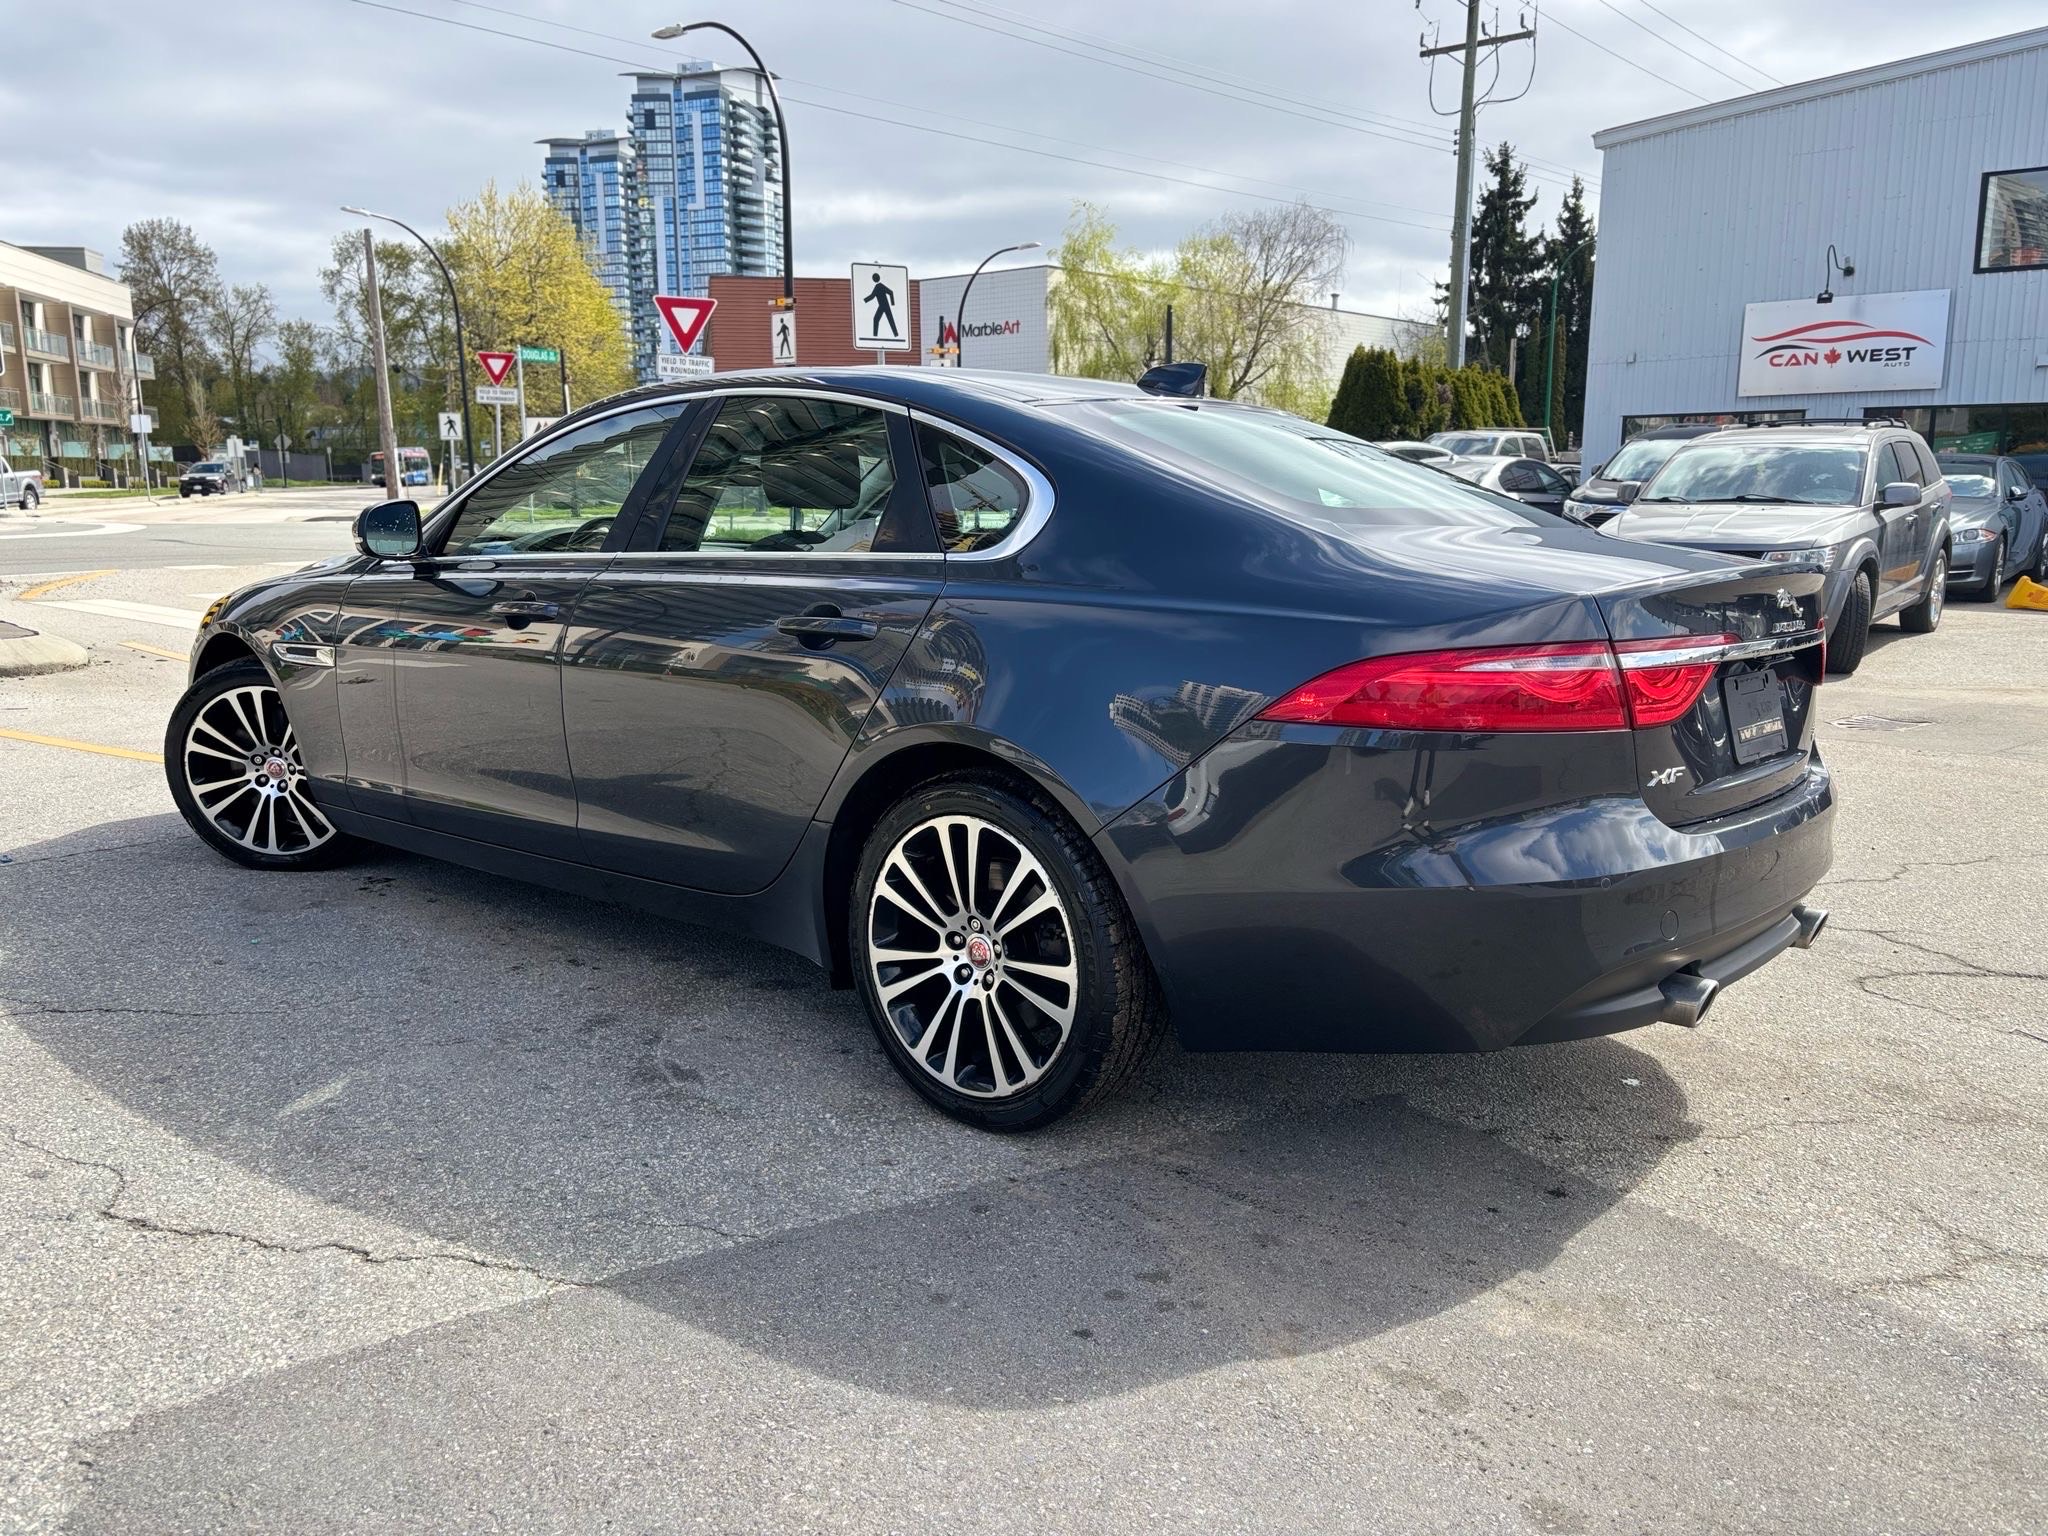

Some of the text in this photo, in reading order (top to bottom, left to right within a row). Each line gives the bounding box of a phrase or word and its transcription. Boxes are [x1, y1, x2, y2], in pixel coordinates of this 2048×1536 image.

[961, 320, 1021, 338] MarbleArt
[522, 349, 548, 360] DOUGLAS
[661, 357, 710, 368] YIELD TO TRAFFIC
[1769, 346, 1918, 367] CAN WEST
[1646, 766, 1686, 787] XF
